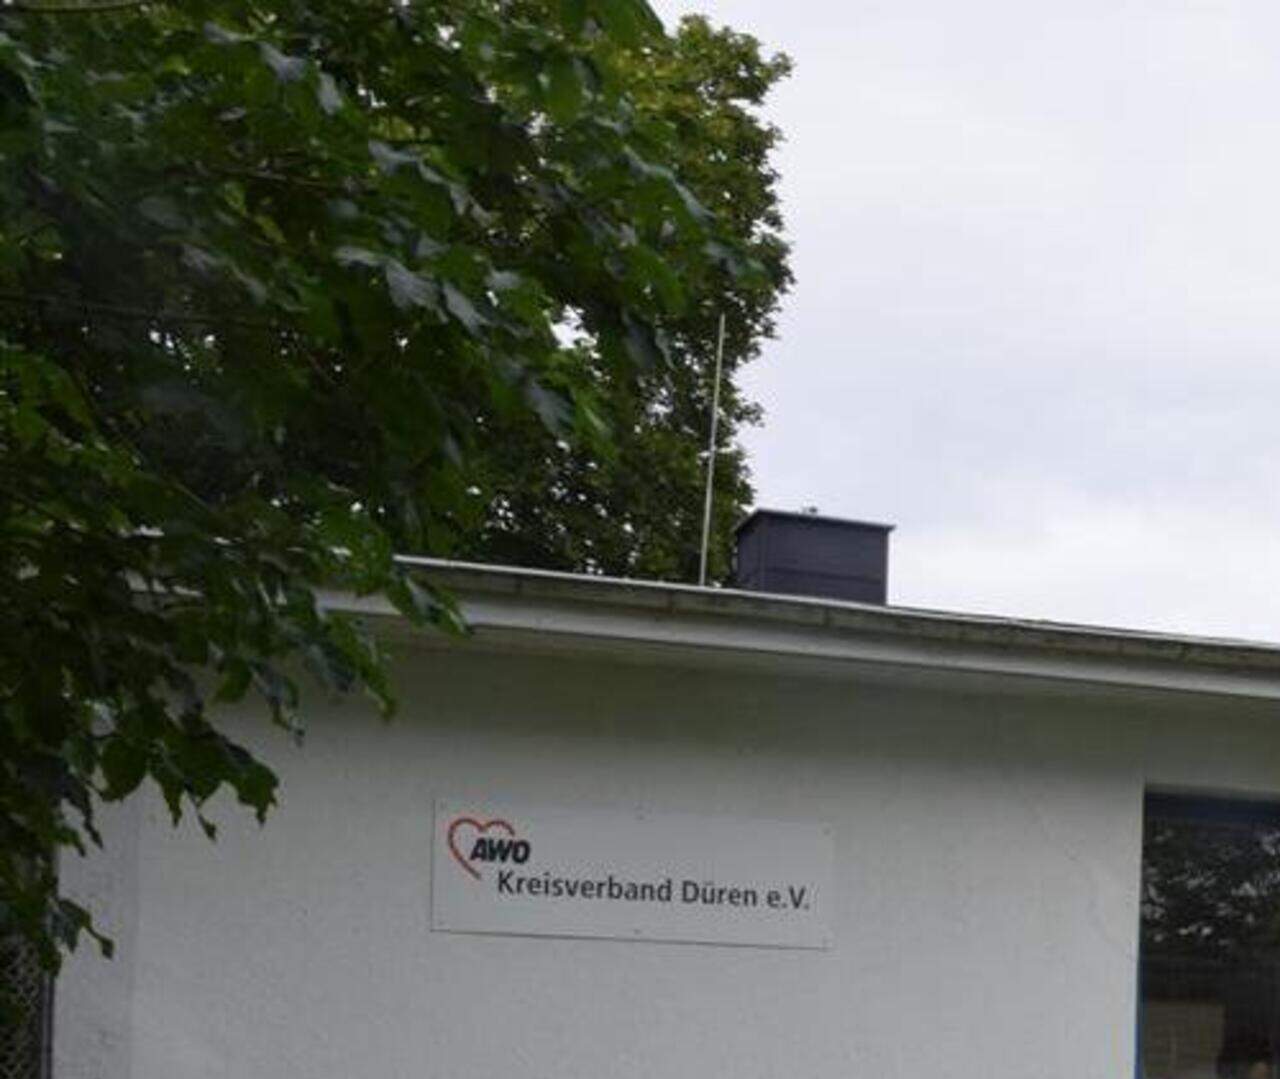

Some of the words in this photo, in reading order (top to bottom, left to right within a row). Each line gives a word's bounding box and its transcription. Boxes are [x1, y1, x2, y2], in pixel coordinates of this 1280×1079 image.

[470, 837, 531, 864] AWO
[497, 871, 672, 902] Kreisverband
[681, 879, 757, 907] Düren
[766, 887, 810, 909] e.V.
